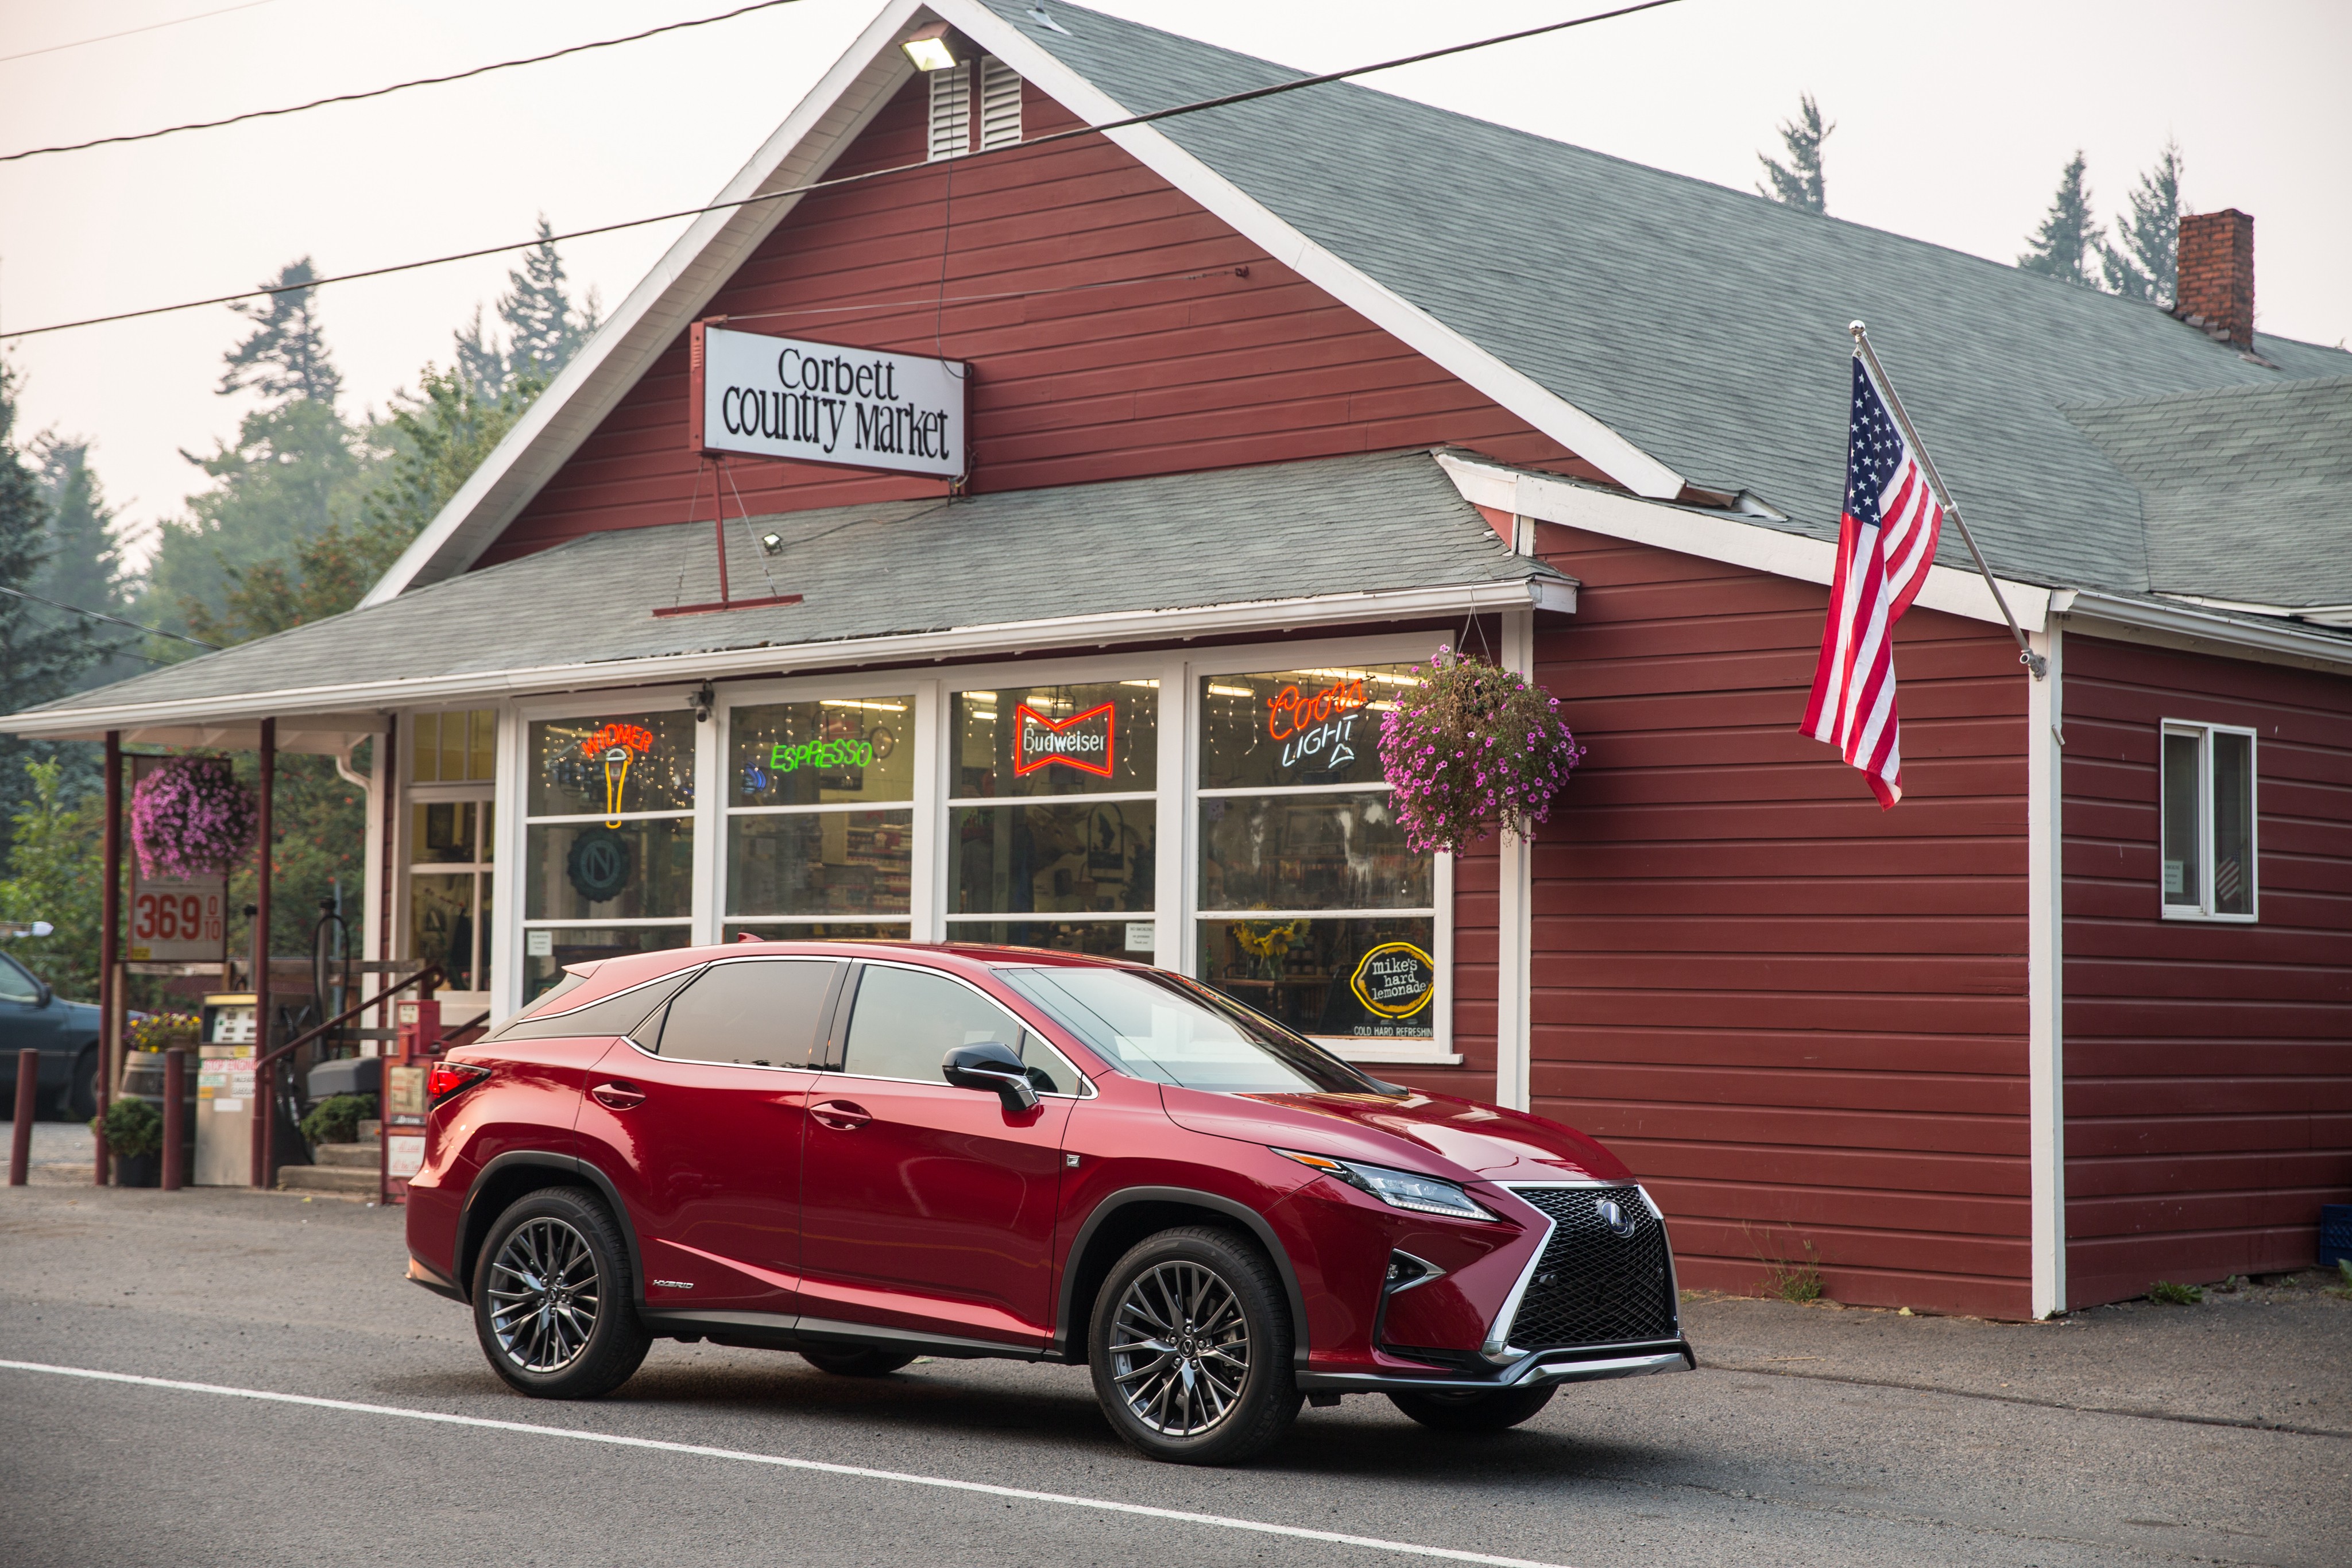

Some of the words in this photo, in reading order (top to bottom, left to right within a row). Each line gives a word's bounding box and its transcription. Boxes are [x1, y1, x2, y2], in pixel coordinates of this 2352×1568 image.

[779, 348, 899, 401] Corbett
[722, 386, 846, 454] Country
[855, 402, 949, 460] Market
[1267, 678, 1367, 740] Coors
[581, 723, 653, 758] WIDMER
[770, 738, 872, 772] ESPRESSO
[1023, 727, 1106, 752] Budweiser
[1282, 714, 1358, 766] LIGHT
[136, 893, 200, 940] 369
[1372, 958, 1418, 975] mike's
[1384, 971, 1415, 987] hard
[1371, 981, 1426, 1000] lemonade
[1354, 1026, 1373, 1036] COLD.
[1374, 1027, 1394, 1036] HARD.
[1396, 1027, 1433, 1037] REFRESHIN
[652, 1279, 694, 1289] HYBRID
